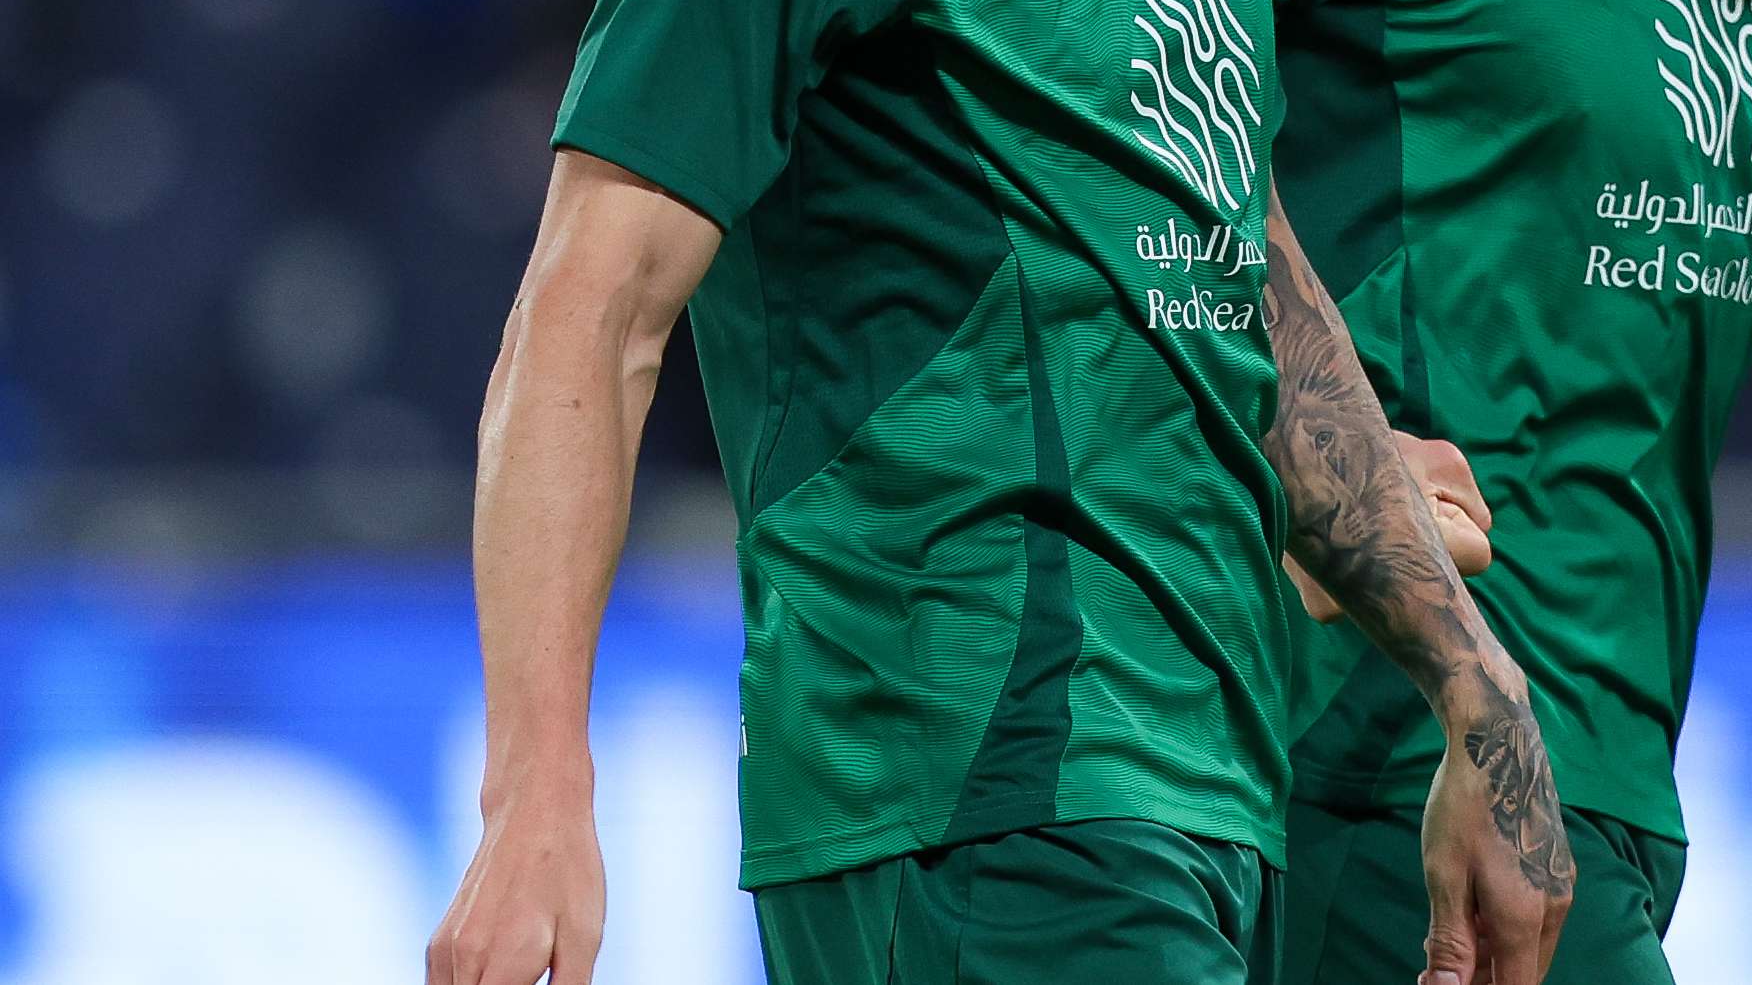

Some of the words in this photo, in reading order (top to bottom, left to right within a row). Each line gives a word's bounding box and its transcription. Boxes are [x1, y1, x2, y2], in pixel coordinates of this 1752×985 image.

[1583, 243, 1666, 292] Red
[1145, 283, 1201, 331] Red
[1198, 289, 1254, 332] Sea
